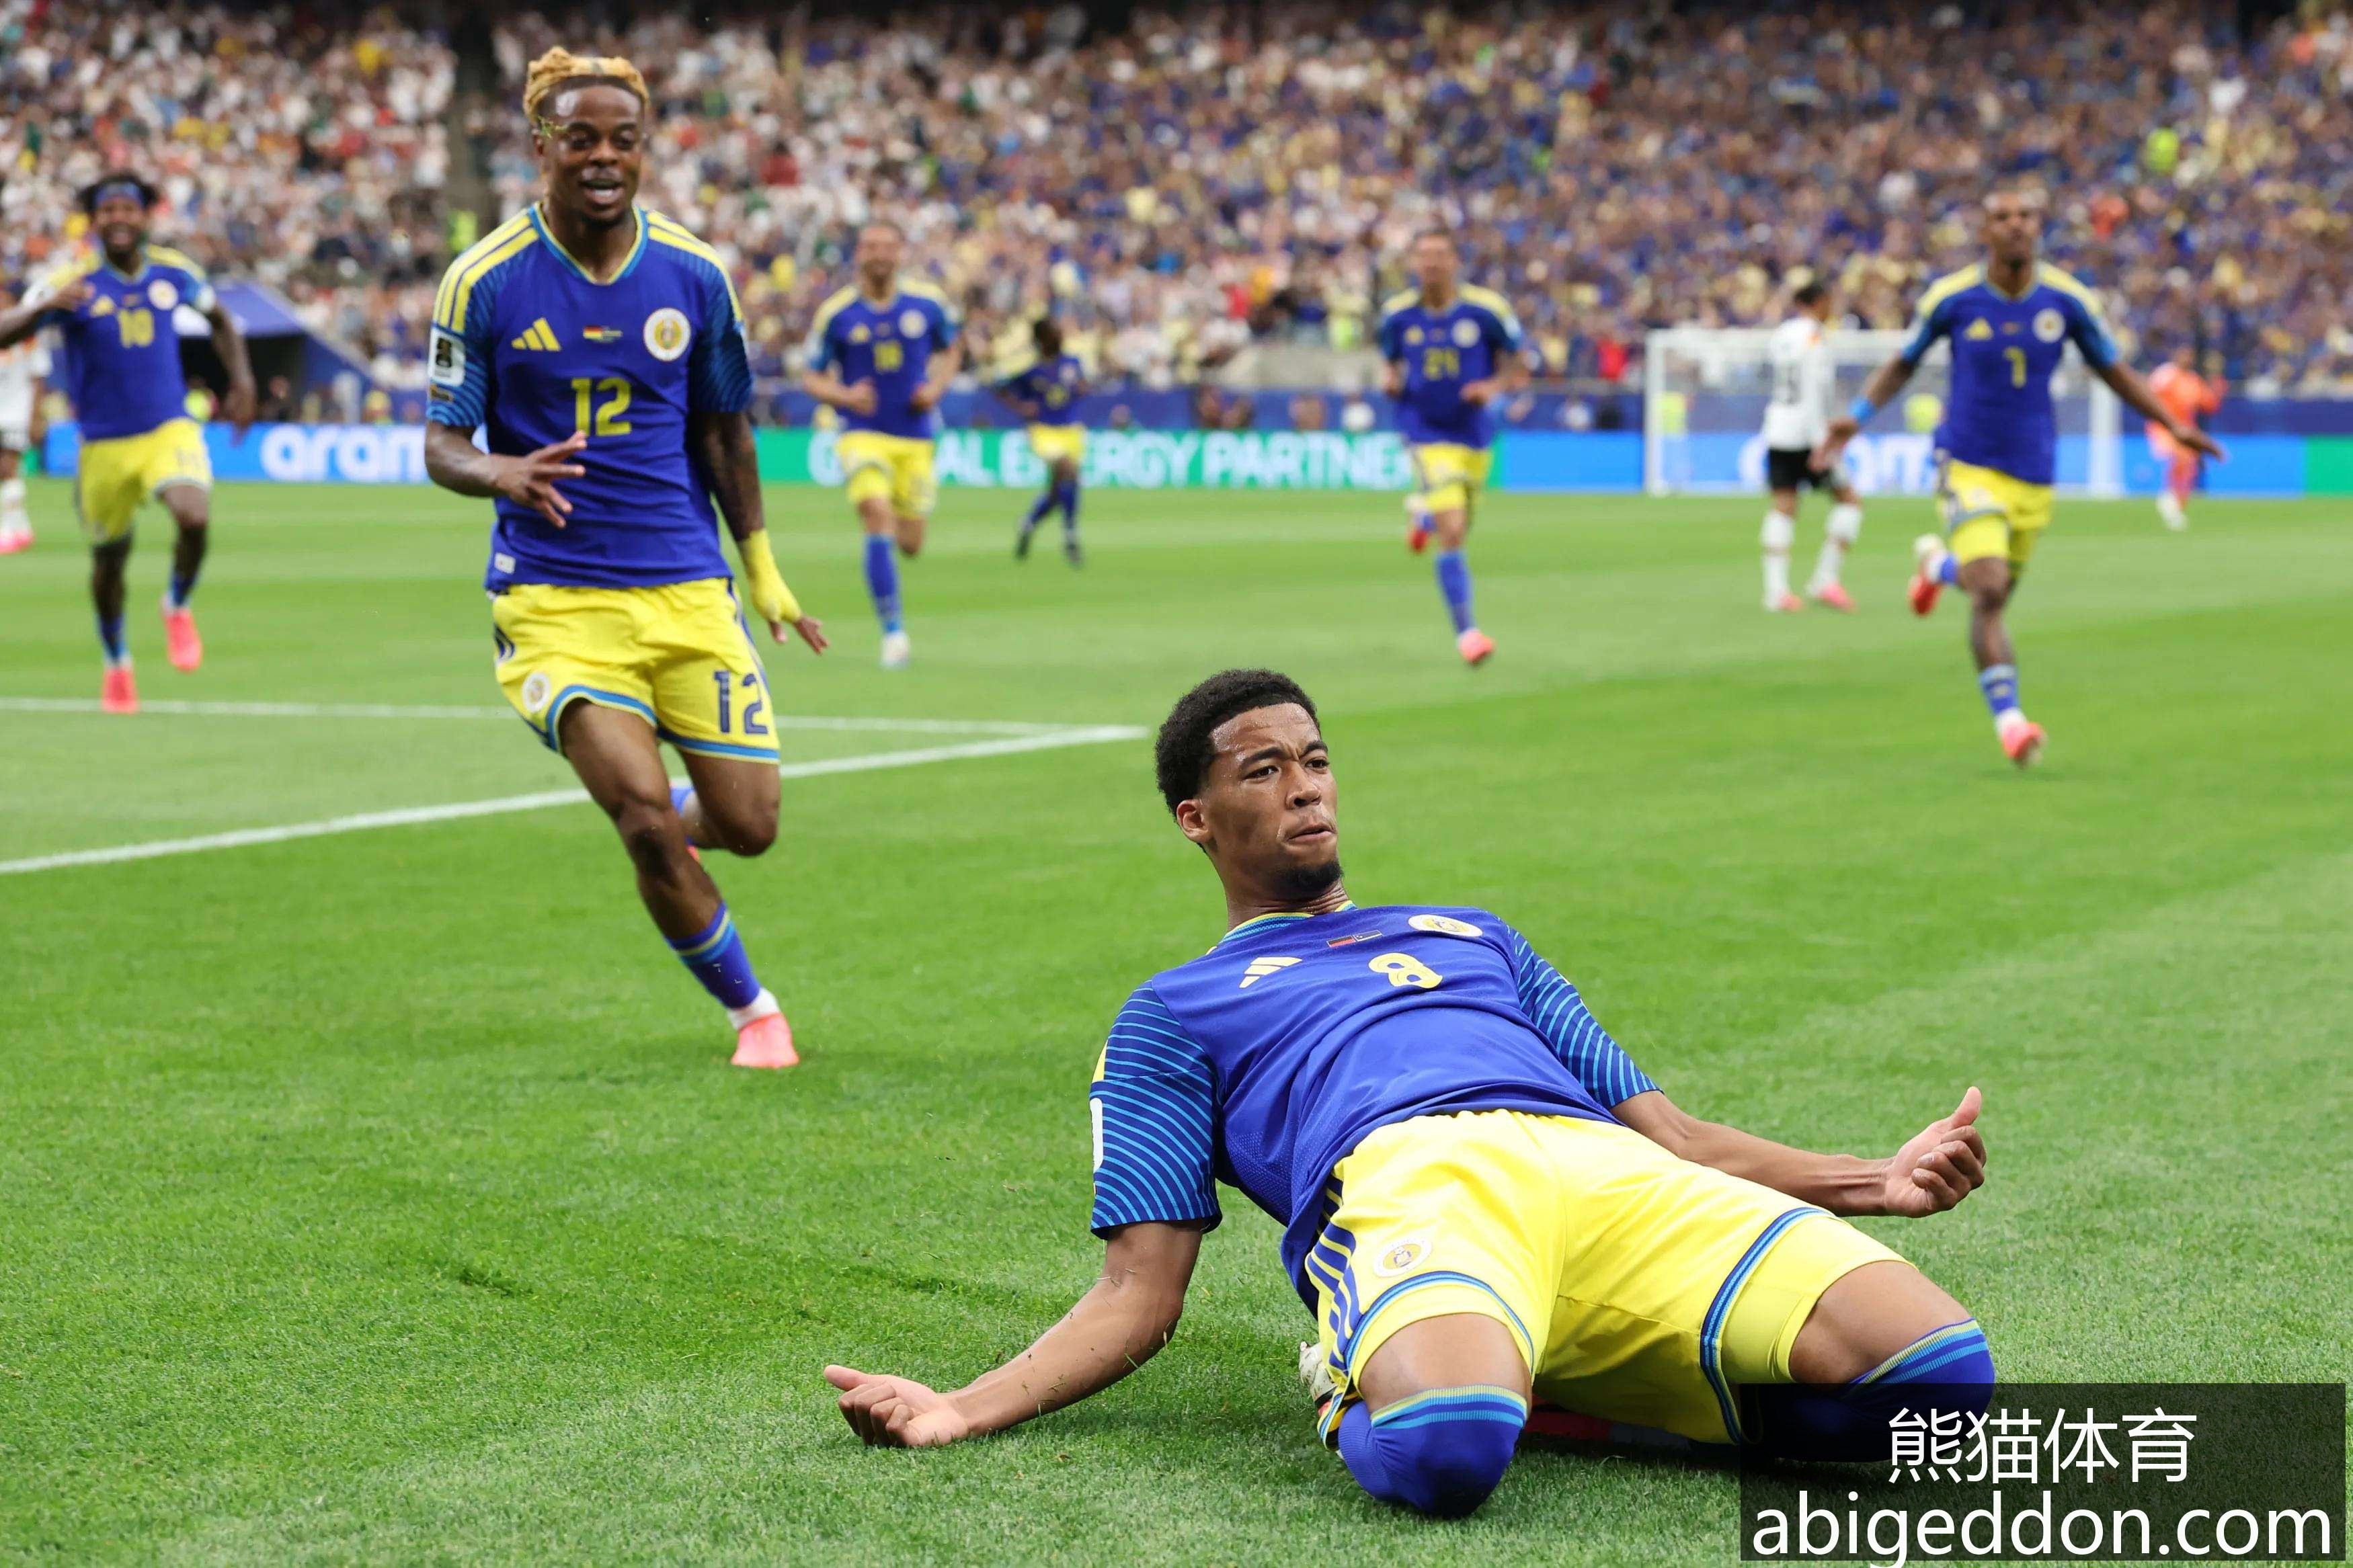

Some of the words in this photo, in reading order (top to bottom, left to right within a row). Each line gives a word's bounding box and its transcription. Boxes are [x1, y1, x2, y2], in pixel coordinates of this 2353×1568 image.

[118, 307, 155, 349] 10
[571, 377, 631, 436] 12
[260, 425, 429, 482] aram
[1202, 430, 1412, 489] PARTNE
[713, 670, 768, 735] 12
[1367, 952, 1443, 989] 8
